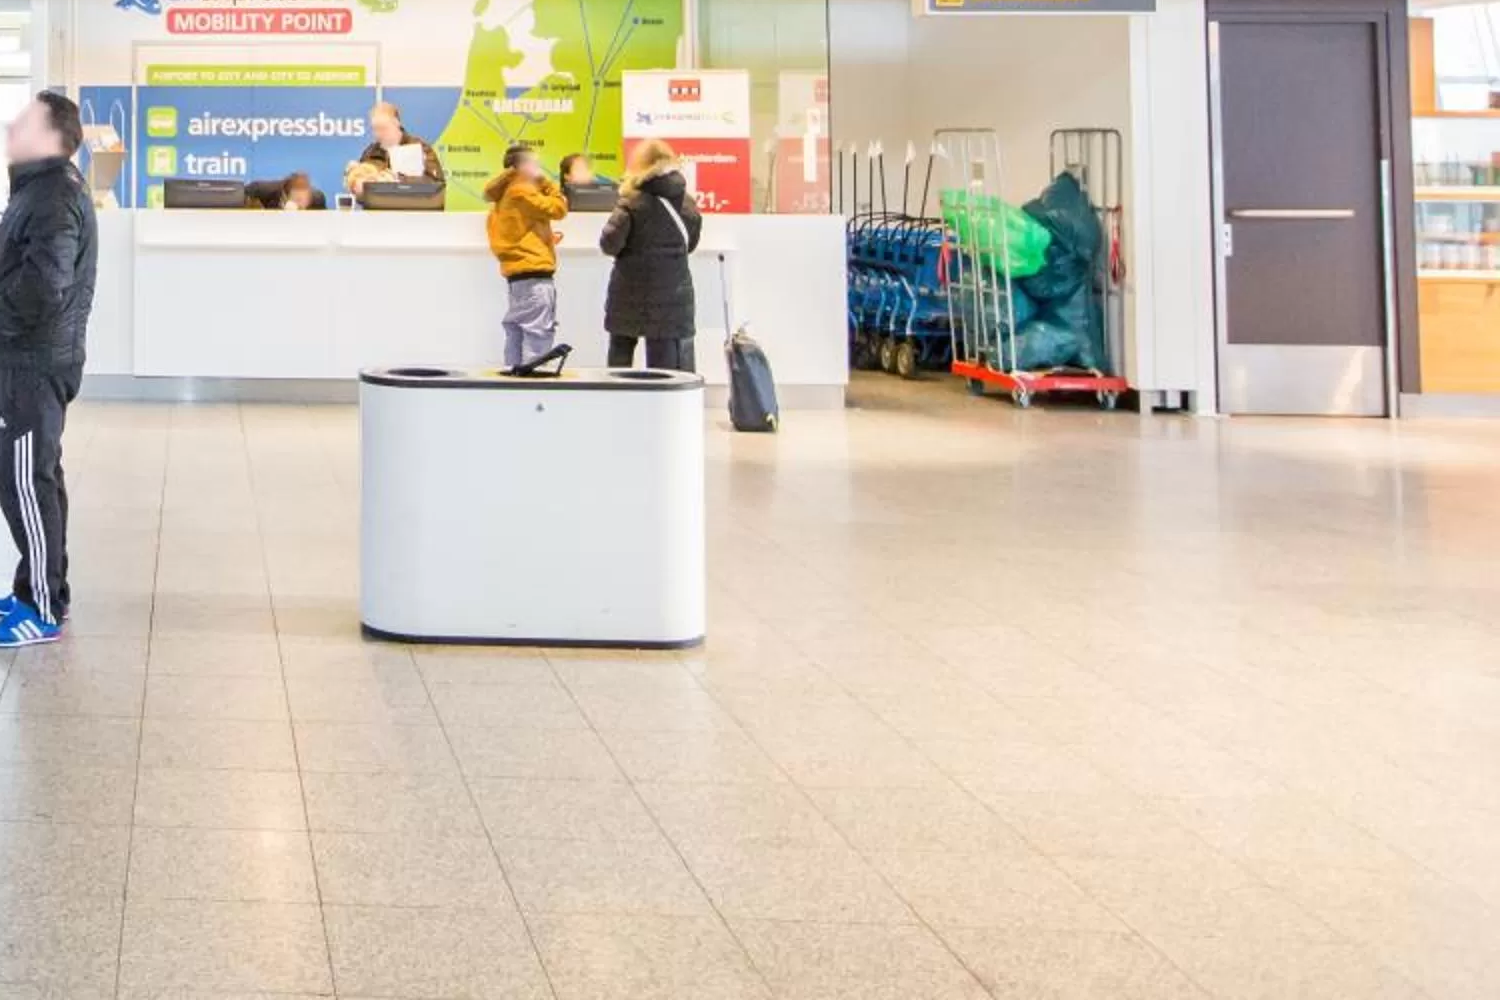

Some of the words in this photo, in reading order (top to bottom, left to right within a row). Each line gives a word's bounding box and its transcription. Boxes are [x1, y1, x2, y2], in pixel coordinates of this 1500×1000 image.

[173, 12, 275, 31] MOBILITY
[280, 12, 346, 31] POINT
[187, 111, 366, 142] airexpressbus
[184, 151, 247, 176] train
